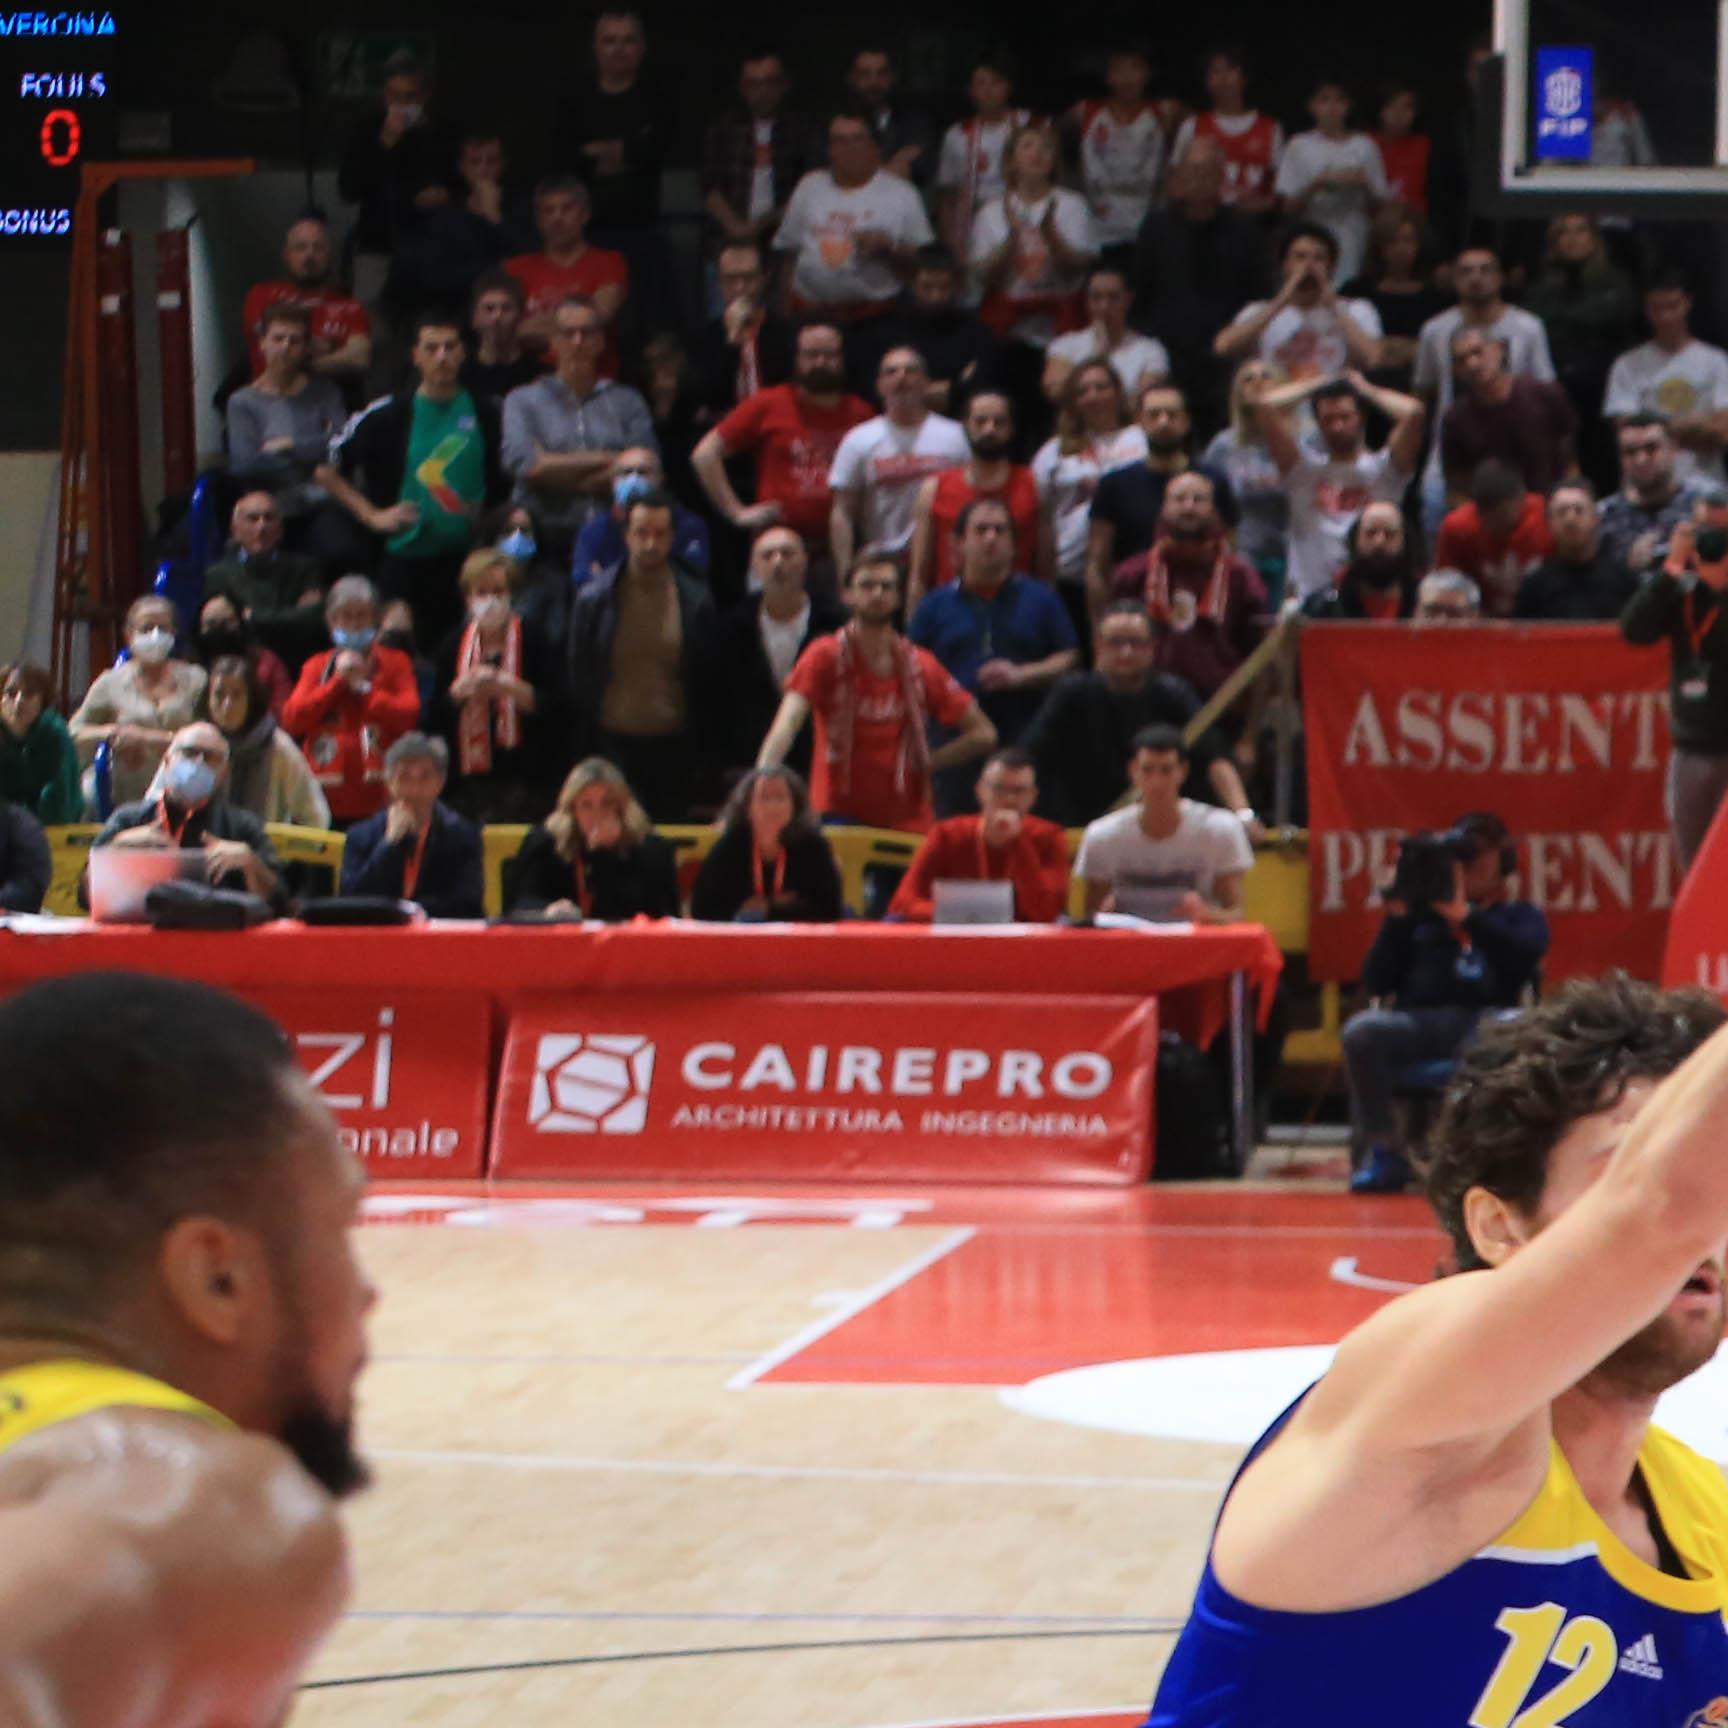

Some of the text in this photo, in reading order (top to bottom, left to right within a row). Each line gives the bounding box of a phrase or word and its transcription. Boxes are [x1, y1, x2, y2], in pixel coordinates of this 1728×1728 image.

[41, 108, 80, 167] 0
[297, 1007, 395, 1110] zi
[682, 1042, 1114, 1100] CAIREPRO
[672, 1102, 1109, 1138] ARCHITETTURA INGEGNERIA
